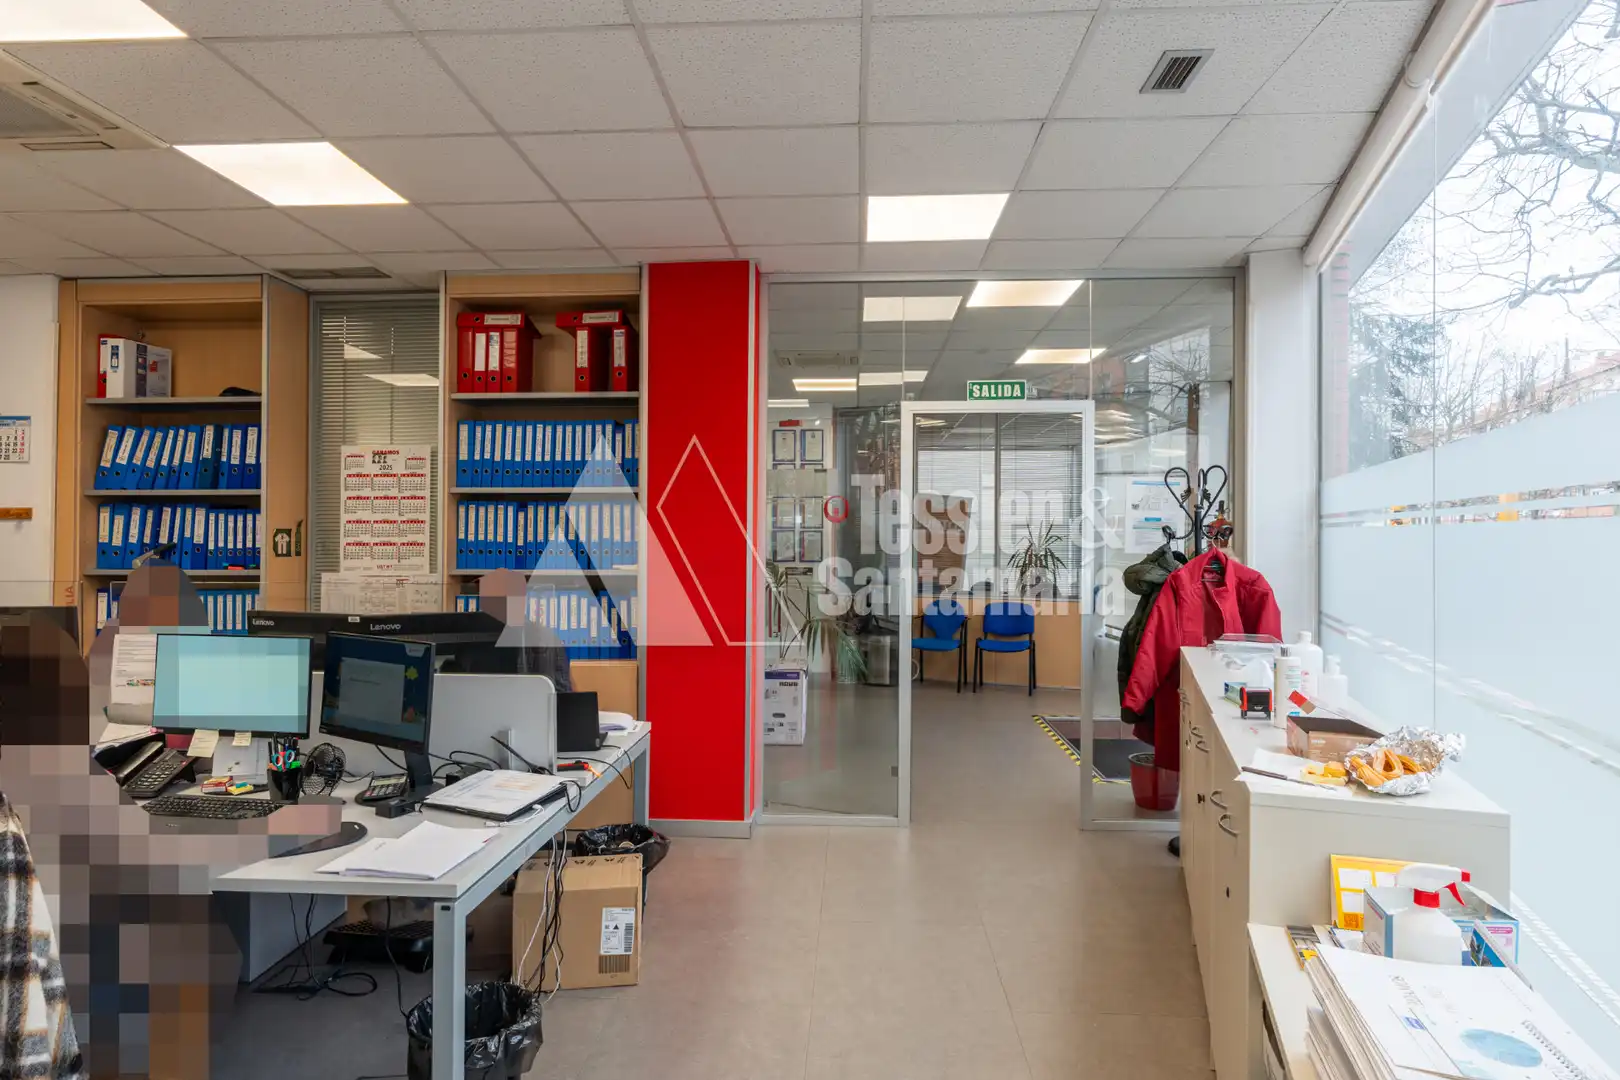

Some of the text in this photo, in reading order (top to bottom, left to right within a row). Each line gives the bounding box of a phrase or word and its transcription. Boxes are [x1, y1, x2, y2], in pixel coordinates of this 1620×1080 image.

[972, 384, 1021, 397] SALIDA
[252, 618, 275, 627] Lenovo
[370, 622, 401, 632] Lenovo
